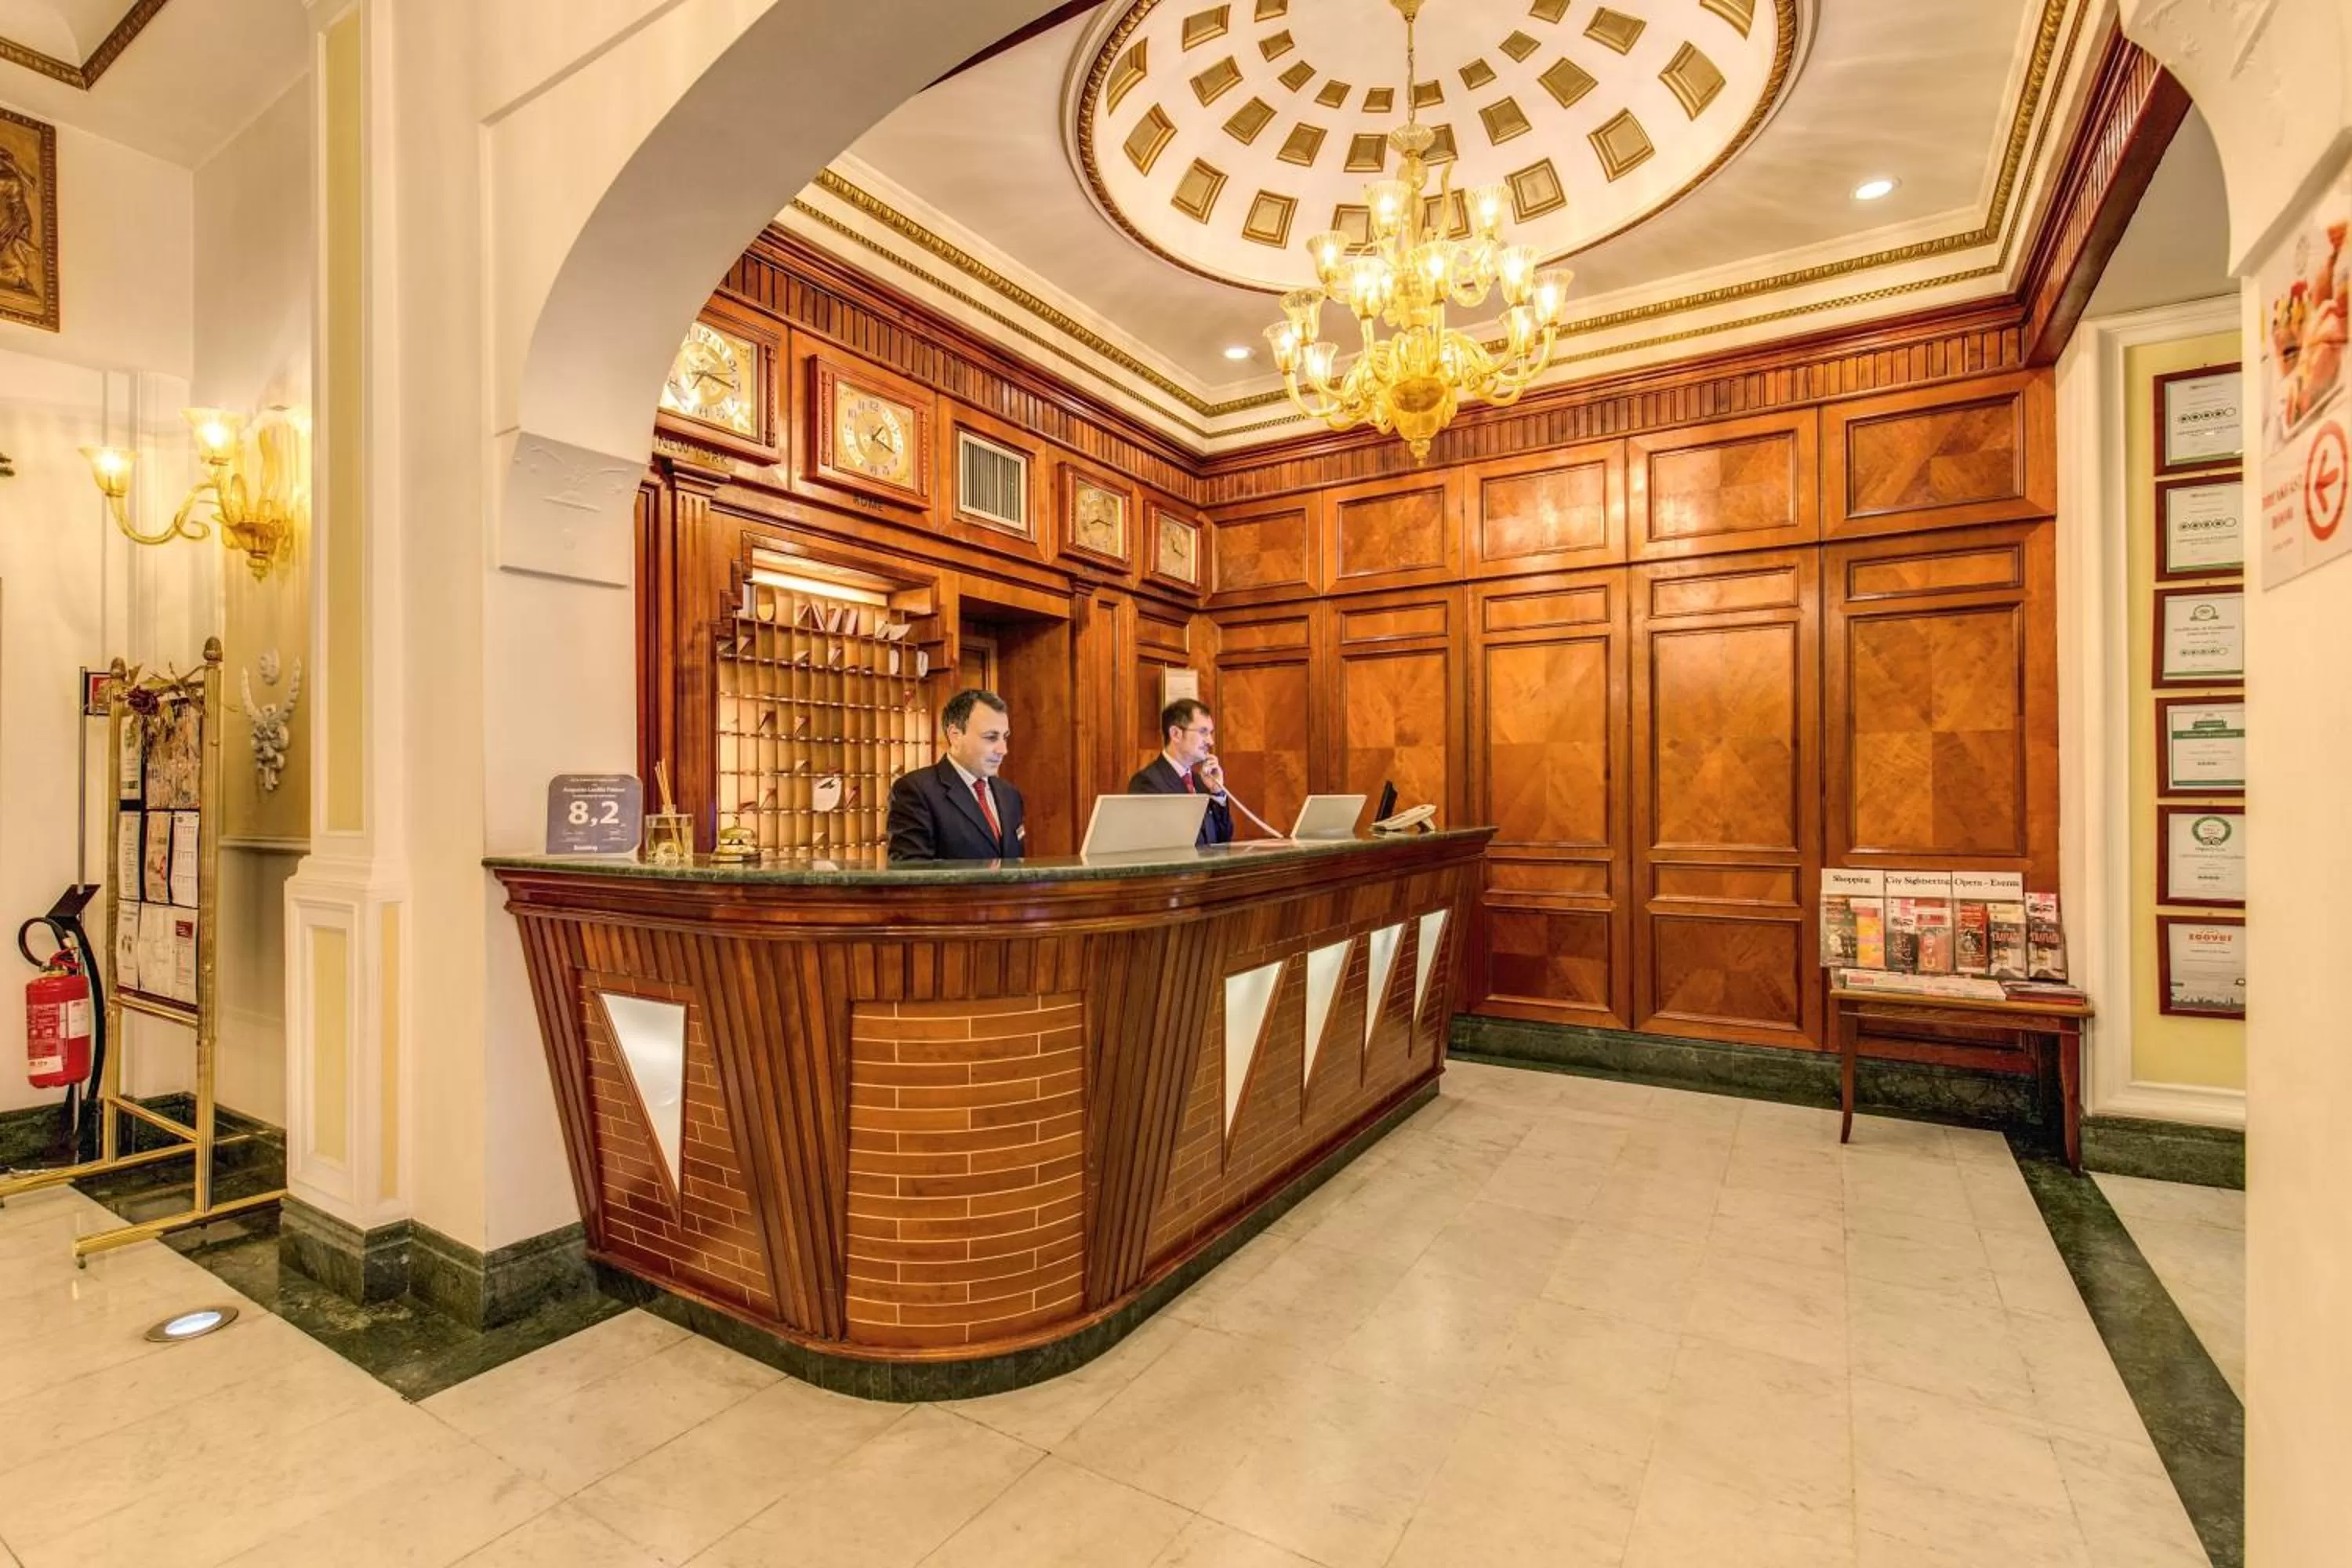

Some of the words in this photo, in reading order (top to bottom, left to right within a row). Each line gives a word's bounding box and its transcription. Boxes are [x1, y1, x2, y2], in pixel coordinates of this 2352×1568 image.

[657, 439, 689, 454] NEW
[568, 800, 619, 827] 8,2
[1832, 874, 1871, 885] Shopping
[1886, 876, 1903, 886] City
[1955, 878, 1983, 887] Opera
[1991, 878, 2020, 887] Events
